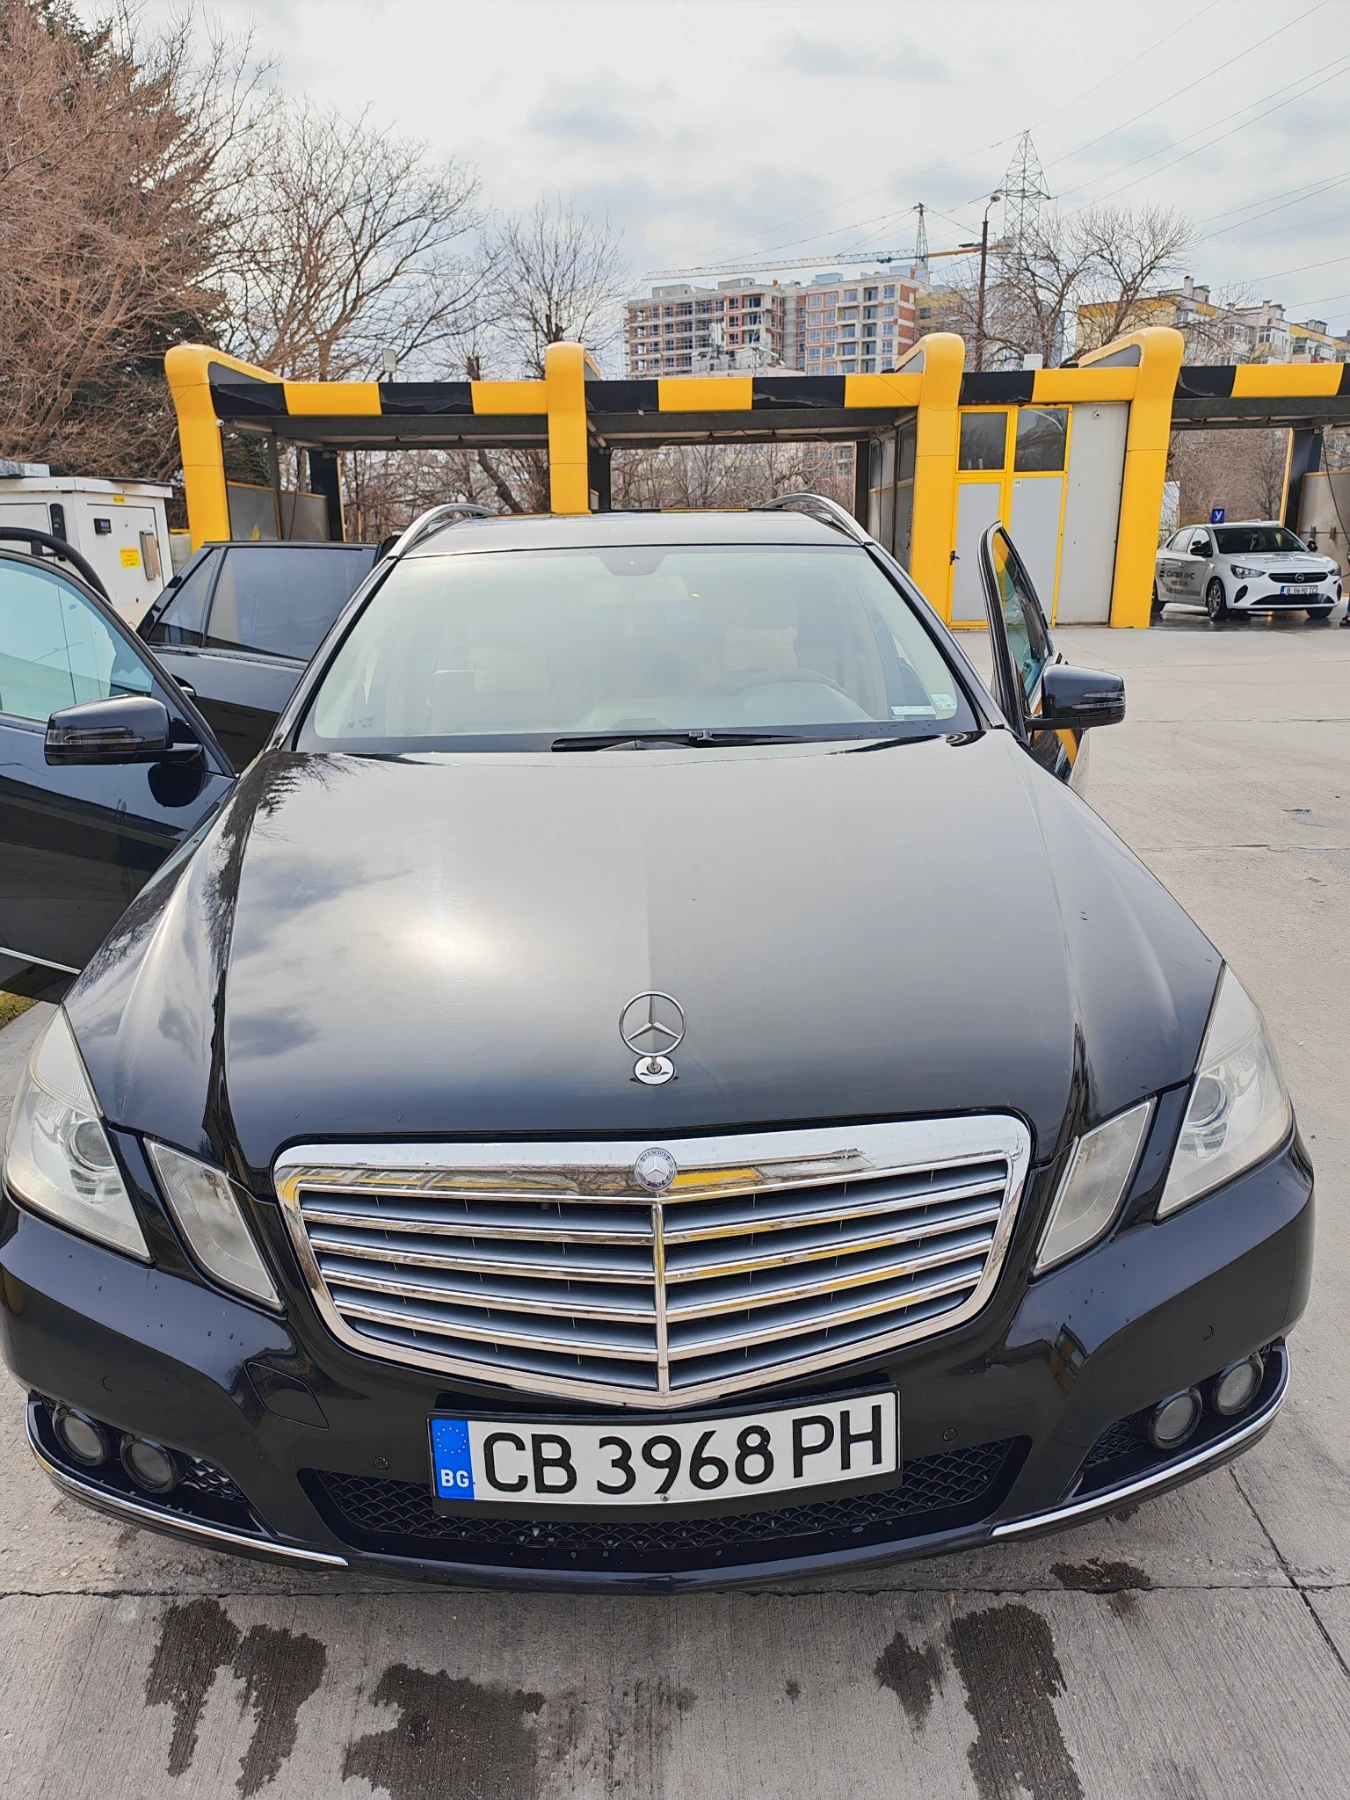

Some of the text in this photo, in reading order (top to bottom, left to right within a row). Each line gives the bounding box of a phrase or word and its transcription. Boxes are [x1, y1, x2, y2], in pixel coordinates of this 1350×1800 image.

[483, 1404, 883, 1496] CB 3968 PH
[441, 1469, 470, 1488] BG
